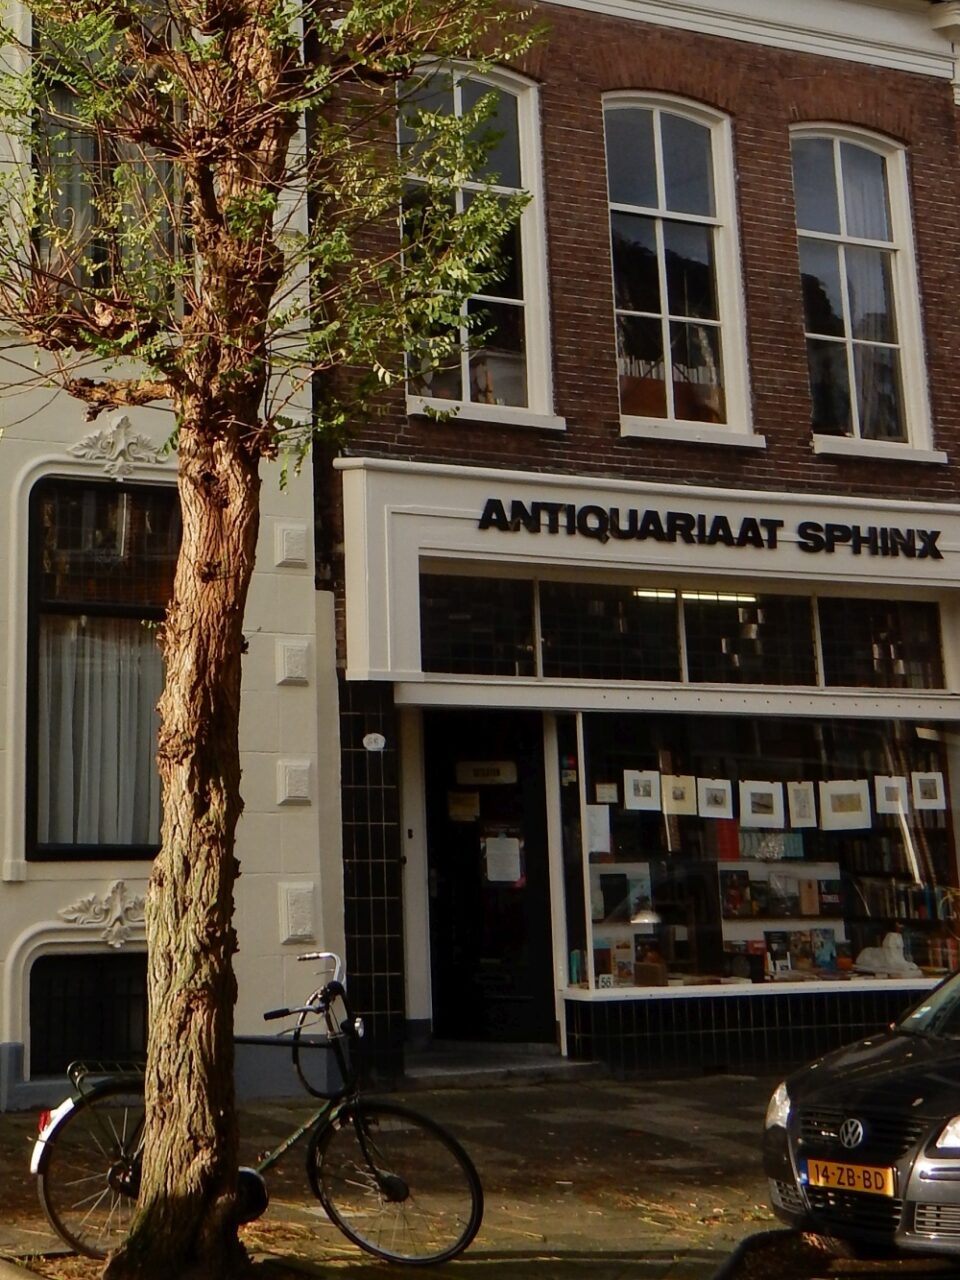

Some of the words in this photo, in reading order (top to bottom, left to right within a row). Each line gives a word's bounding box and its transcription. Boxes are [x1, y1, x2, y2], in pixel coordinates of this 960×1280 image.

[478, 498, 784, 549] ANTIQUARIAAT
[797, 521, 944, 560] SPHINX
[814, 1163, 885, 1191] 14-ZB-BD
